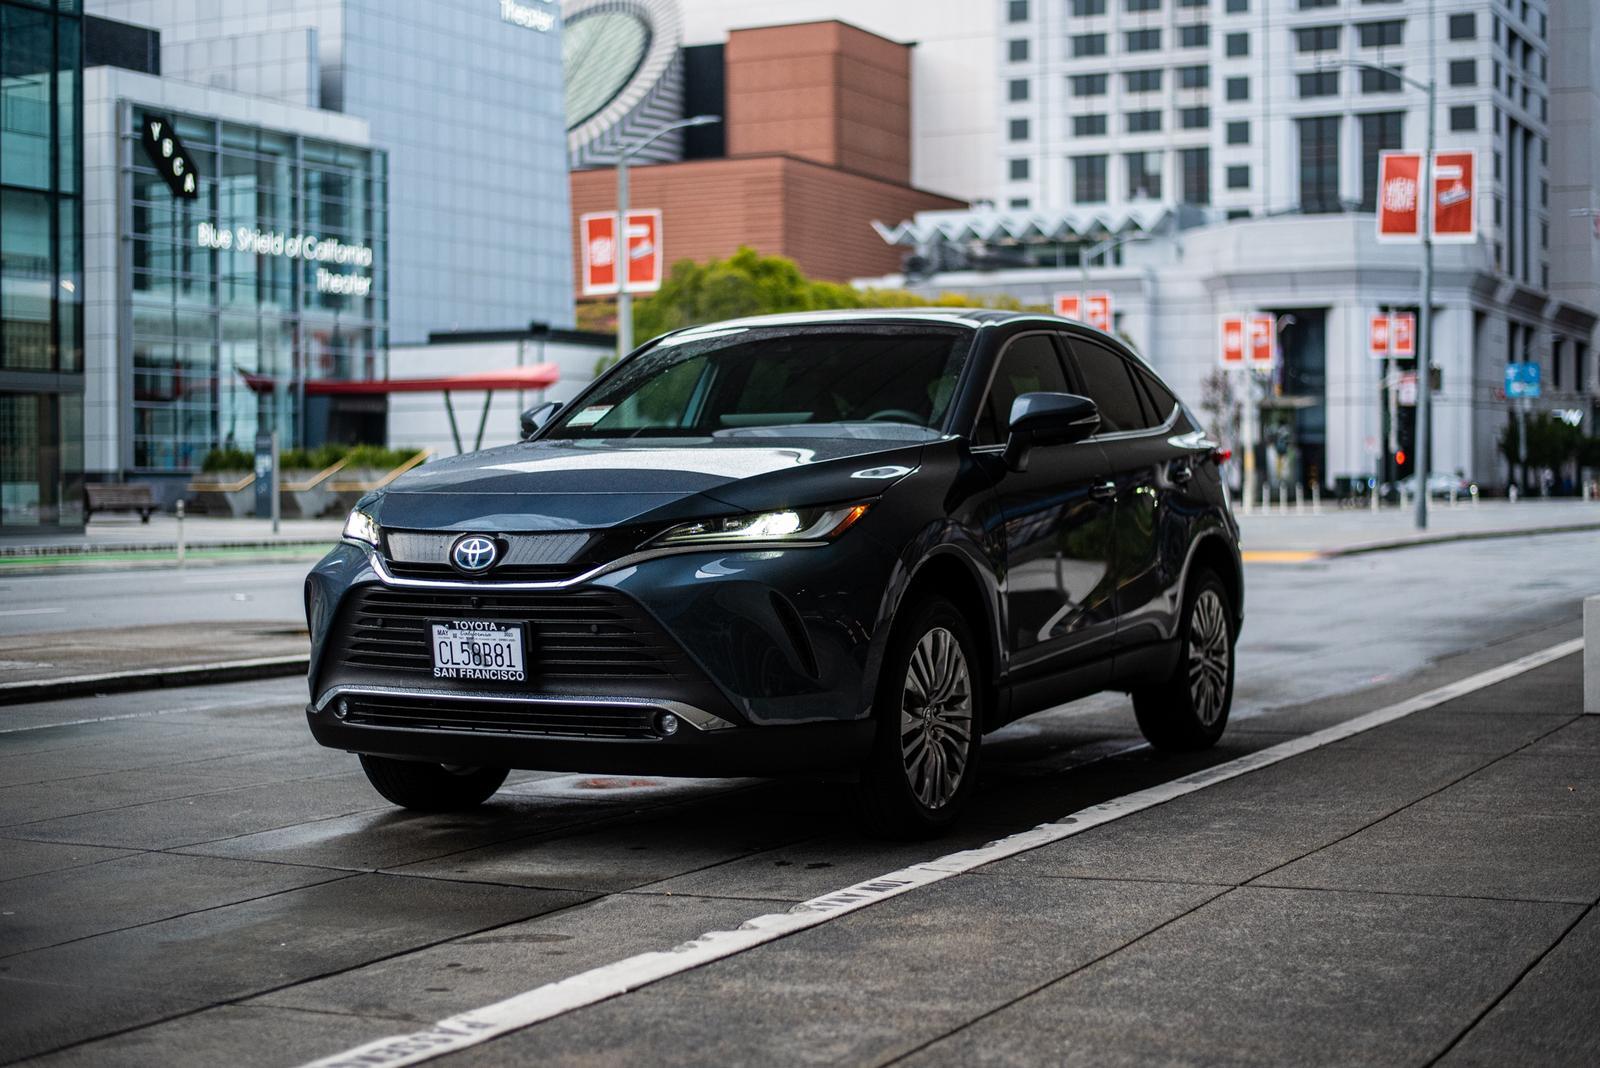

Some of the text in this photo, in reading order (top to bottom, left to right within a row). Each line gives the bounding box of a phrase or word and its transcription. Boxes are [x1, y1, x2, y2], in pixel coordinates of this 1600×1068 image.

[150, 121, 195, 193] YBCA
[197, 222, 373, 267] Blue Shield of California
[316, 266, 372, 297] Theater
[453, 620, 498, 631] TOYOTA
[438, 640, 516, 668] CL58B81
[433, 667, 525, 681] SAN FRANCISCO
